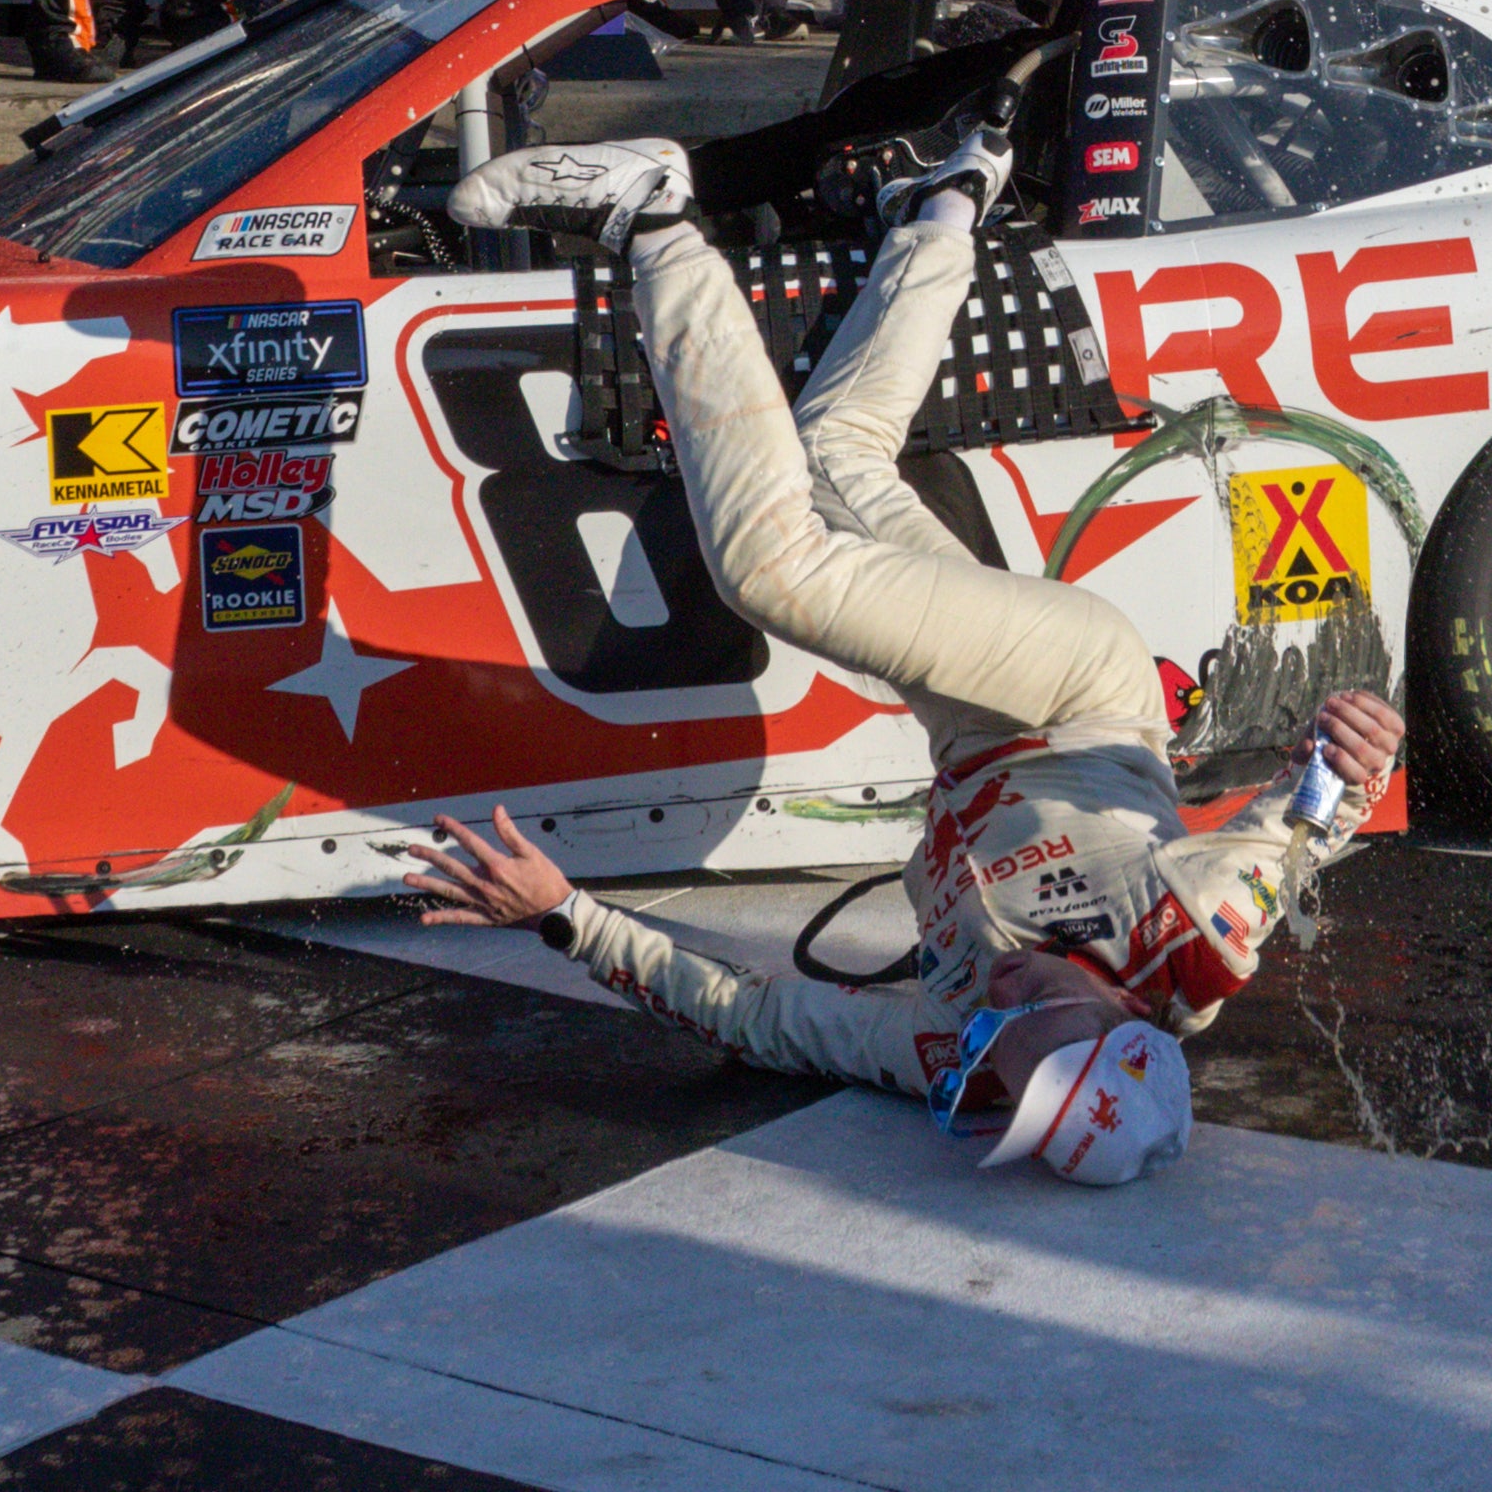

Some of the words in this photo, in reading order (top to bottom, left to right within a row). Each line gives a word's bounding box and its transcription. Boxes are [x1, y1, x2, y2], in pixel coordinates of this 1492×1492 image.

[1111, 97, 1147, 109] Miller
[1111, 109, 1148, 117] Welders
[1092, 146, 1133, 168] SEM
[249, 212, 333, 231] NASCAR
[217, 234, 275, 251] RACE
[281, 233, 325, 247] CAR
[247, 311, 310, 329] NASCAR
[207, 330, 335, 376] xfinity
[246, 366, 298, 383] SERIES
[177, 401, 360, 445] COMETIC
[189, 439, 258, 451] GASKET
[198, 450, 335, 494] Holley
[53, 478, 164, 502] KENNAMETAL
[197, 489, 315, 523] MSD
[32, 518, 89, 540] FIVE
[95, 512, 153, 532] STAR
[213, 552, 293, 573] SUNOCO
[210, 589, 296, 609] ROOKIE
[1247, 576, 1354, 609] KOA
[1140, 906, 1176, 944] OMP
